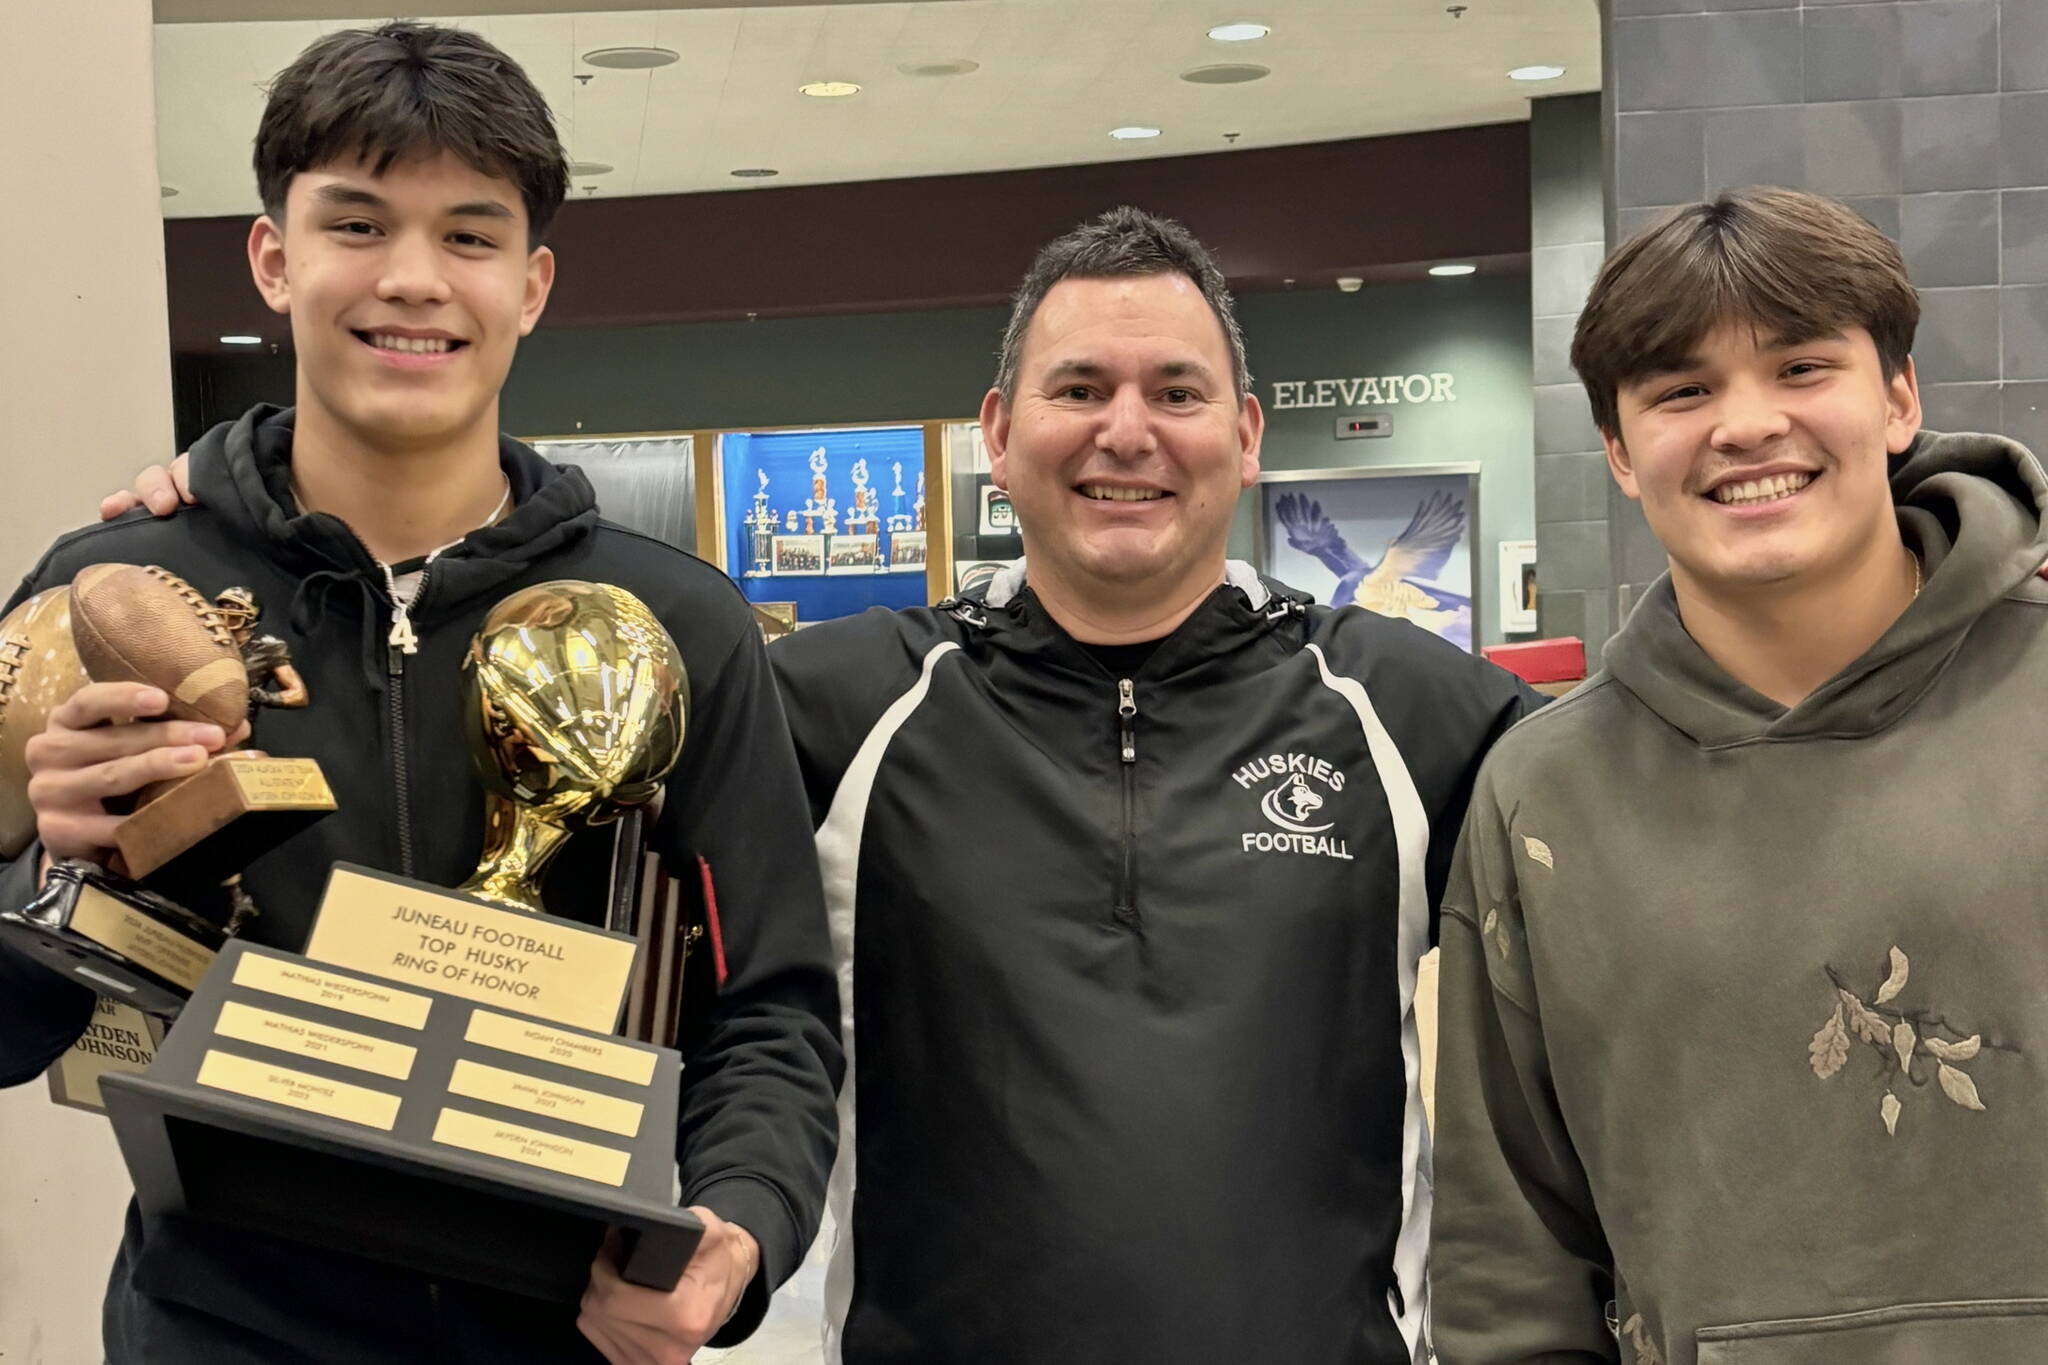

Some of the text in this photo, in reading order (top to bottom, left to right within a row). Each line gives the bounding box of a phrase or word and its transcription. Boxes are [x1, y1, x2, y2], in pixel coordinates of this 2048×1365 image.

[1272, 373, 1456, 409] ELEVATOR
[1232, 753, 1345, 791] HUSKIES
[1241, 832, 1354, 860] FOOTBALL
[391, 905, 565, 961] JUNEAU FOOTBALL
[418, 935, 530, 974] TOP HUSKY
[391, 951, 541, 1000] RING OF HONOR
[97, 1002, 116, 1016] AR
[74, 1038, 153, 1065] OHNSON
[86, 1024, 141, 1047] YDEN
